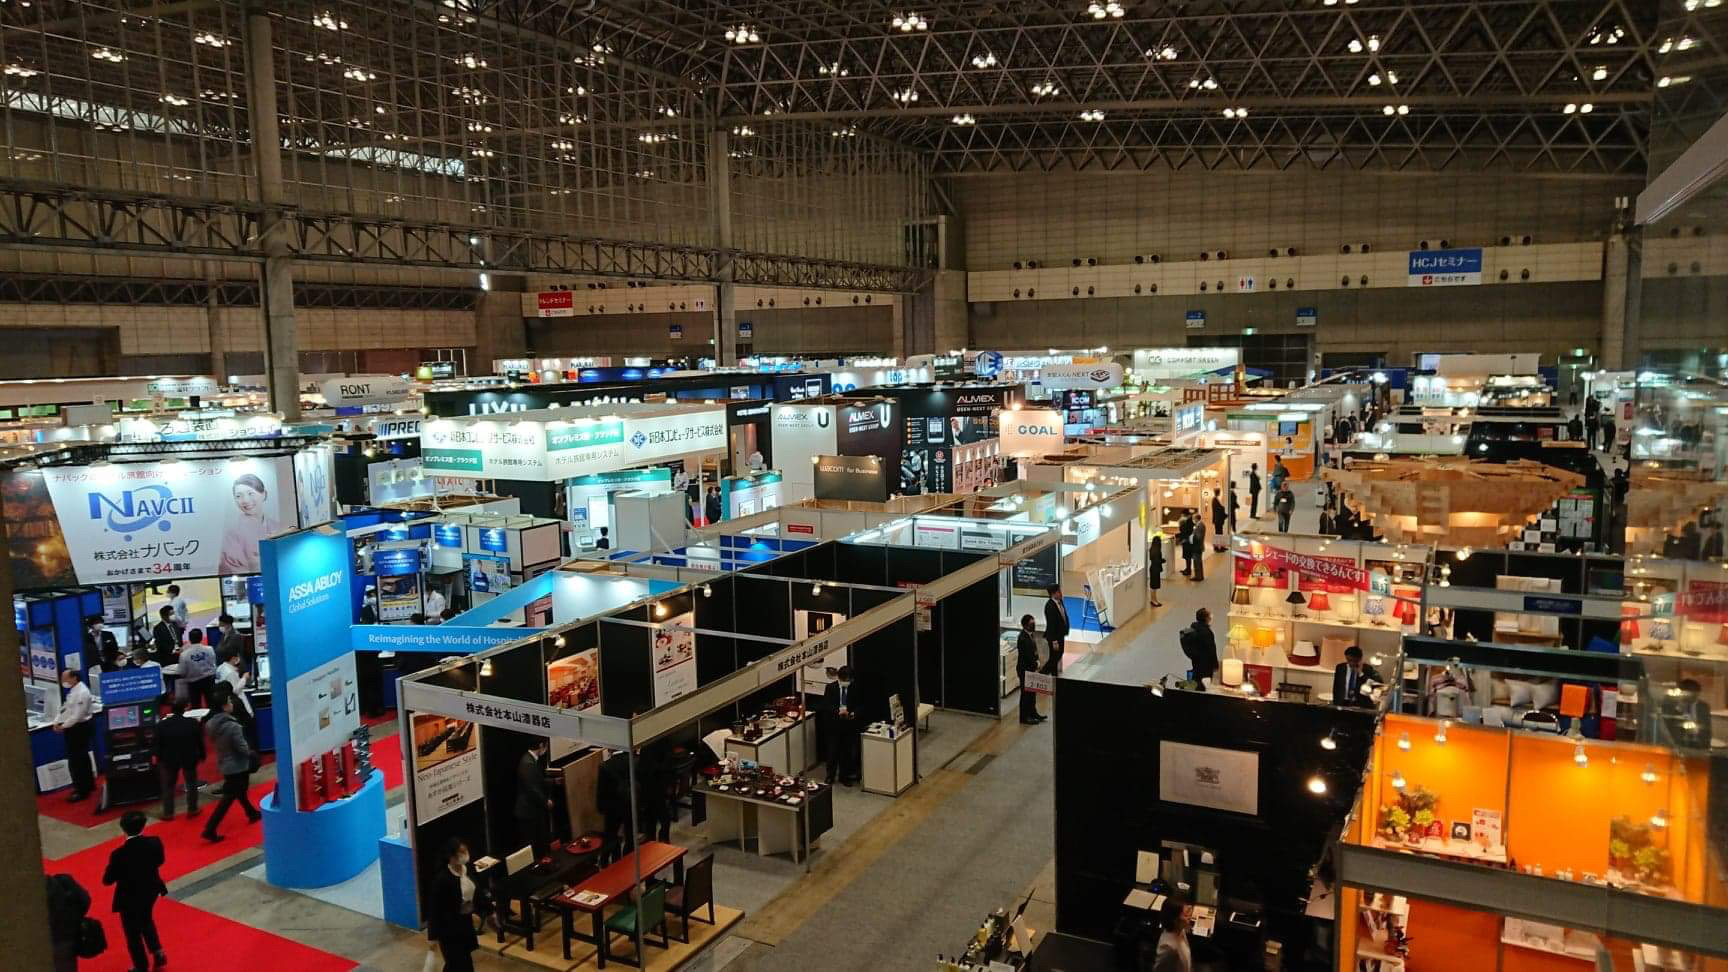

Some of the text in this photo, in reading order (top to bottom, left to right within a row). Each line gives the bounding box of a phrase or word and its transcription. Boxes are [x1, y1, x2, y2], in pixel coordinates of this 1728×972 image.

[1412, 256, 1478, 268] HCJセミナー
[956, 394, 995, 404] ALMEX
[777, 413, 808, 421] ALMEX
[849, 411, 874, 423] ALMEX
[1017, 425, 1058, 436] GOAL
[88, 490, 195, 520] NAVCII
[93, 538, 200, 562] 株式会社ナバック
[288, 570, 343, 602] ASSA ABLOY
[368, 634, 522, 646] Reimagining the World of Hospit
[466, 702, 551, 728] 株式会社本山漆器店
